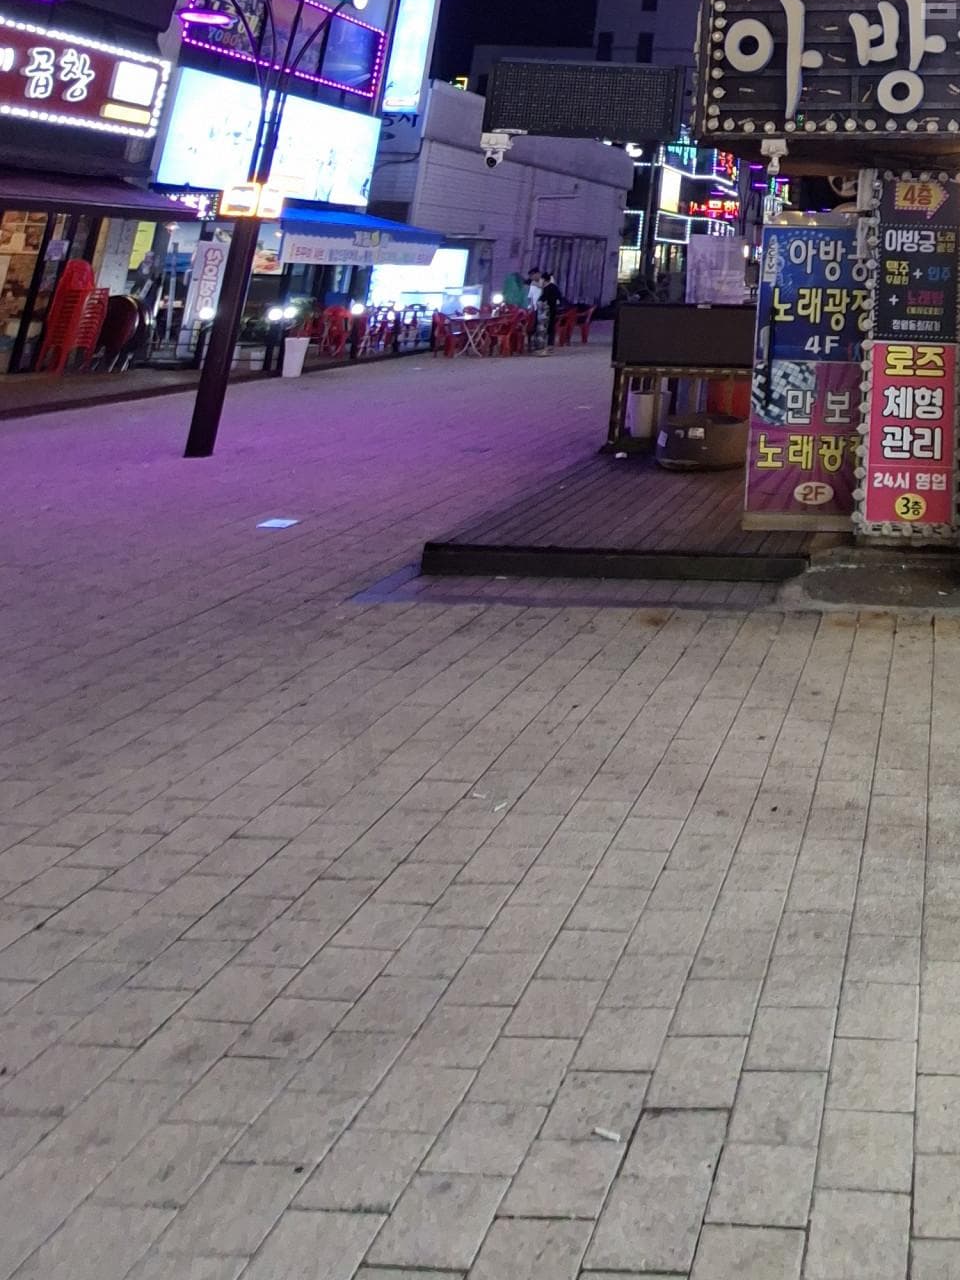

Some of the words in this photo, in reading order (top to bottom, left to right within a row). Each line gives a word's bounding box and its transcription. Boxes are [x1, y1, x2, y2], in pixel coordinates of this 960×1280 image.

[23, 47, 96, 102] 곱창
[902, 184, 933, 206] 4층
[885, 229, 936, 253] 아방궁
[804, 335, 841, 355] 4F
[885, 345, 945, 377] 로즈
[786, 390, 851, 424] 만보
[883, 385, 944, 420] 체형
[757, 434, 861, 473] 노래광
[882, 425, 943, 460] 관리
[802, 485, 827, 502] 2F
[872, 471, 910, 489] 24시
[900, 496, 924, 516] 3층
